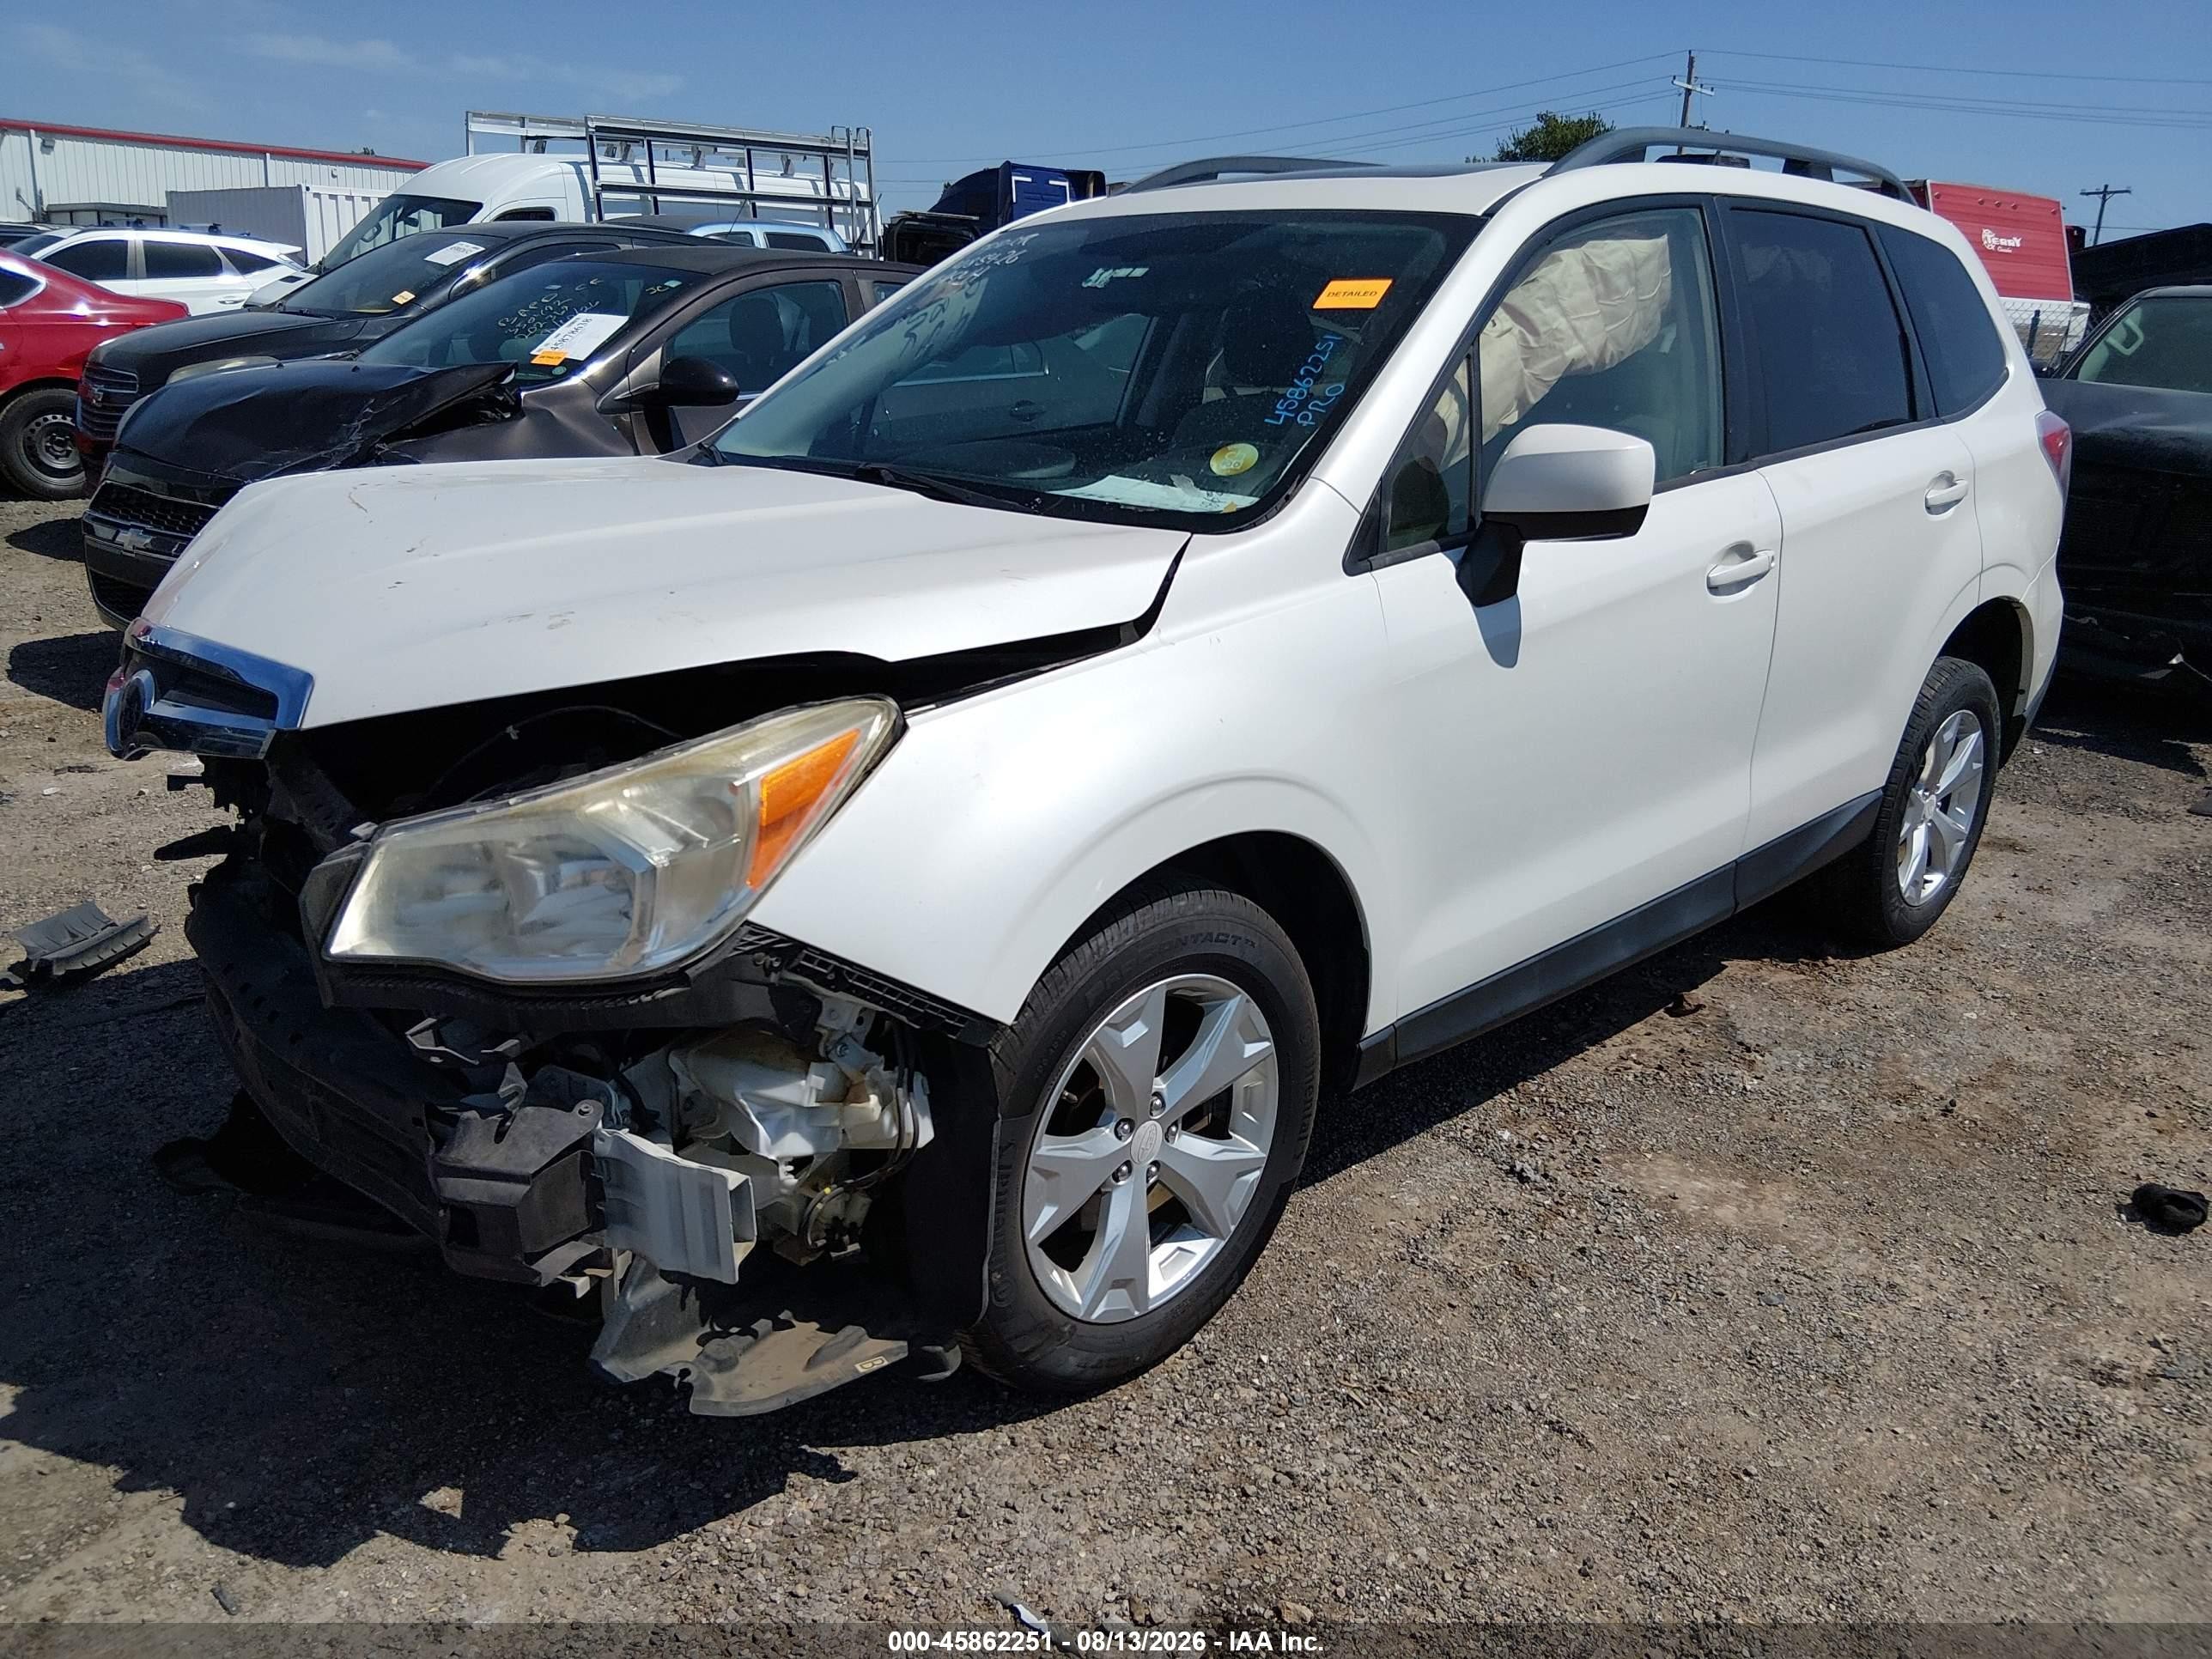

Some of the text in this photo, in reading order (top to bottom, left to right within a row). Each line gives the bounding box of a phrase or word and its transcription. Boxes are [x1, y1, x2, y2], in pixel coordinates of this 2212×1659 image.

[1264, 336, 1343, 425] 45862251
[1297, 384, 1345, 426] PRO
[860, 1358, 885, 1370] B
